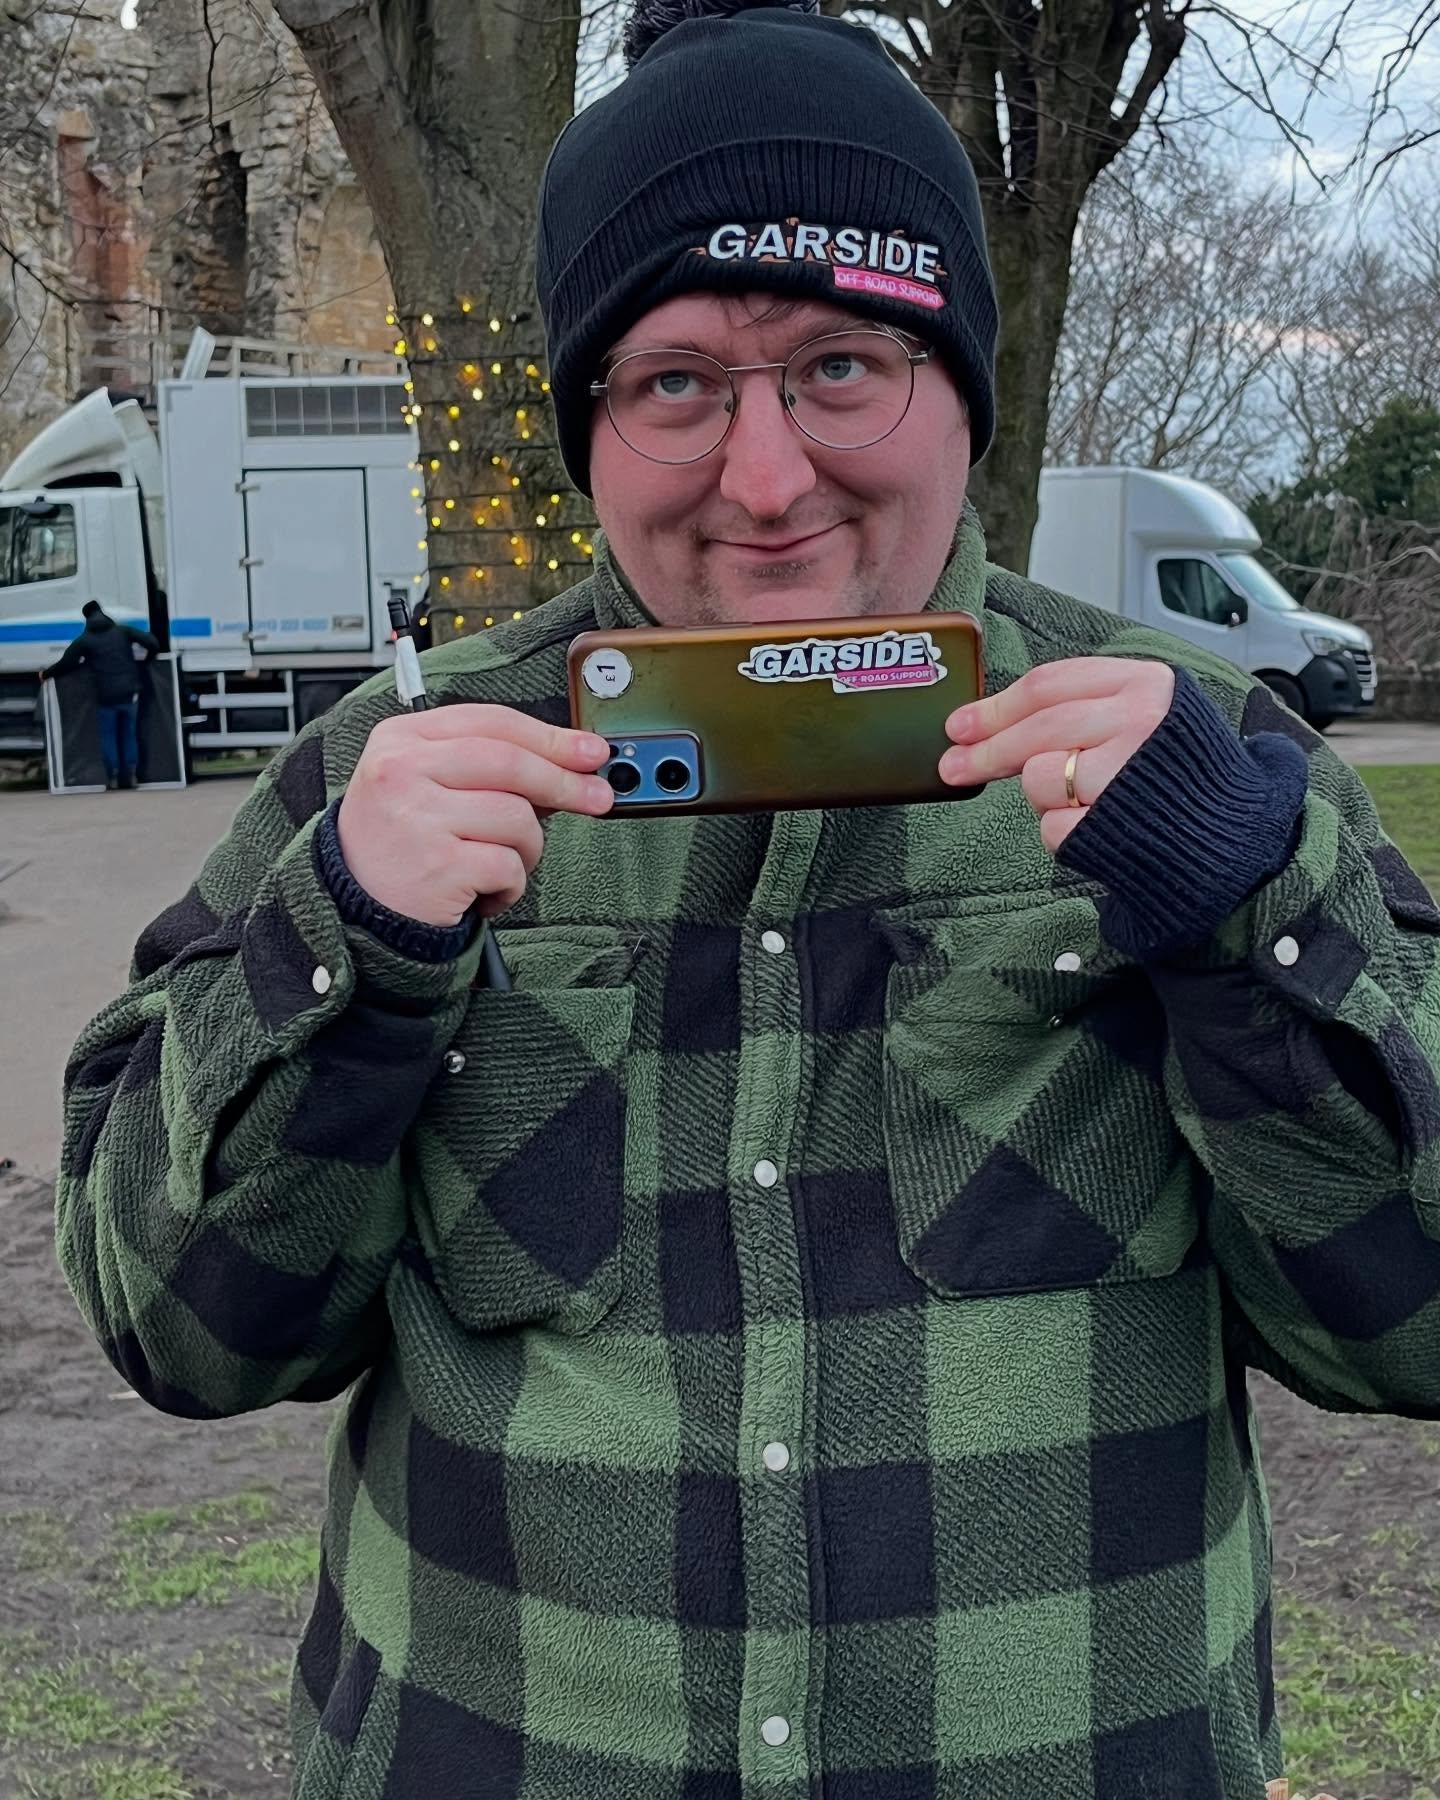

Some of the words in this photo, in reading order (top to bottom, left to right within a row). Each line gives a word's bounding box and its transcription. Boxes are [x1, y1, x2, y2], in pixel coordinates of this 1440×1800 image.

[708, 224, 939, 283] GARSIDE
[836, 272, 896, 292] OFF-ROAD
[899, 283, 940, 304] SUPPORT
[754, 639, 926, 678] GARSIDE
